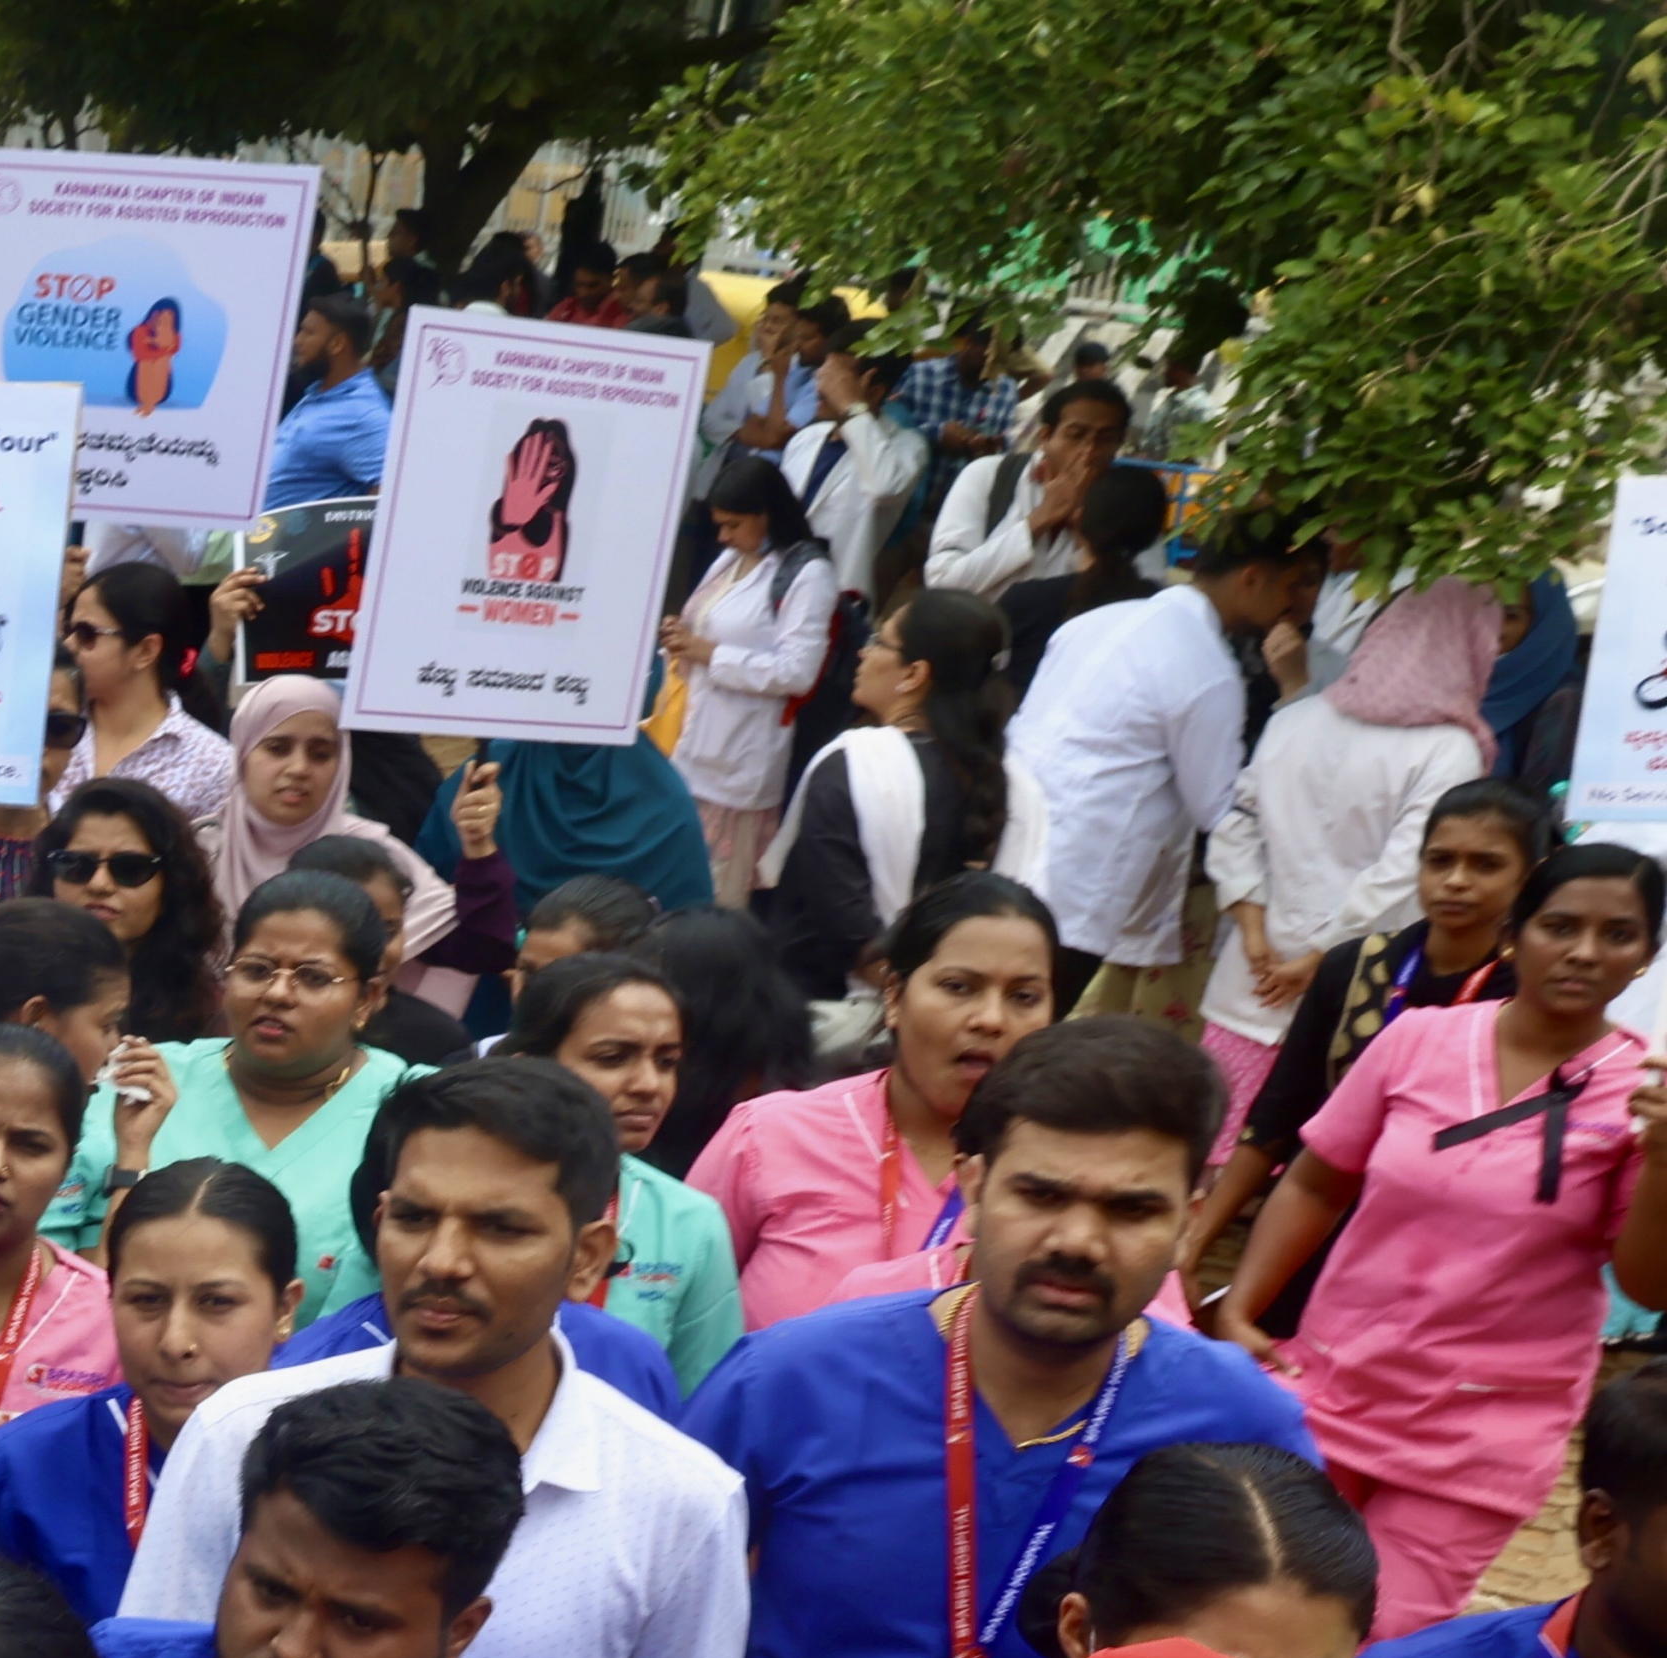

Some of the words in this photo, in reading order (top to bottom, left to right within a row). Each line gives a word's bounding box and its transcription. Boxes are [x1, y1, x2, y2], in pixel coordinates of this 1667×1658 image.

[35, 274, 115, 301] STOP
[18, 303, 120, 331] GENDER
[15, 327, 117, 350] VIOLENCE
[311, 608, 361, 634] ST
